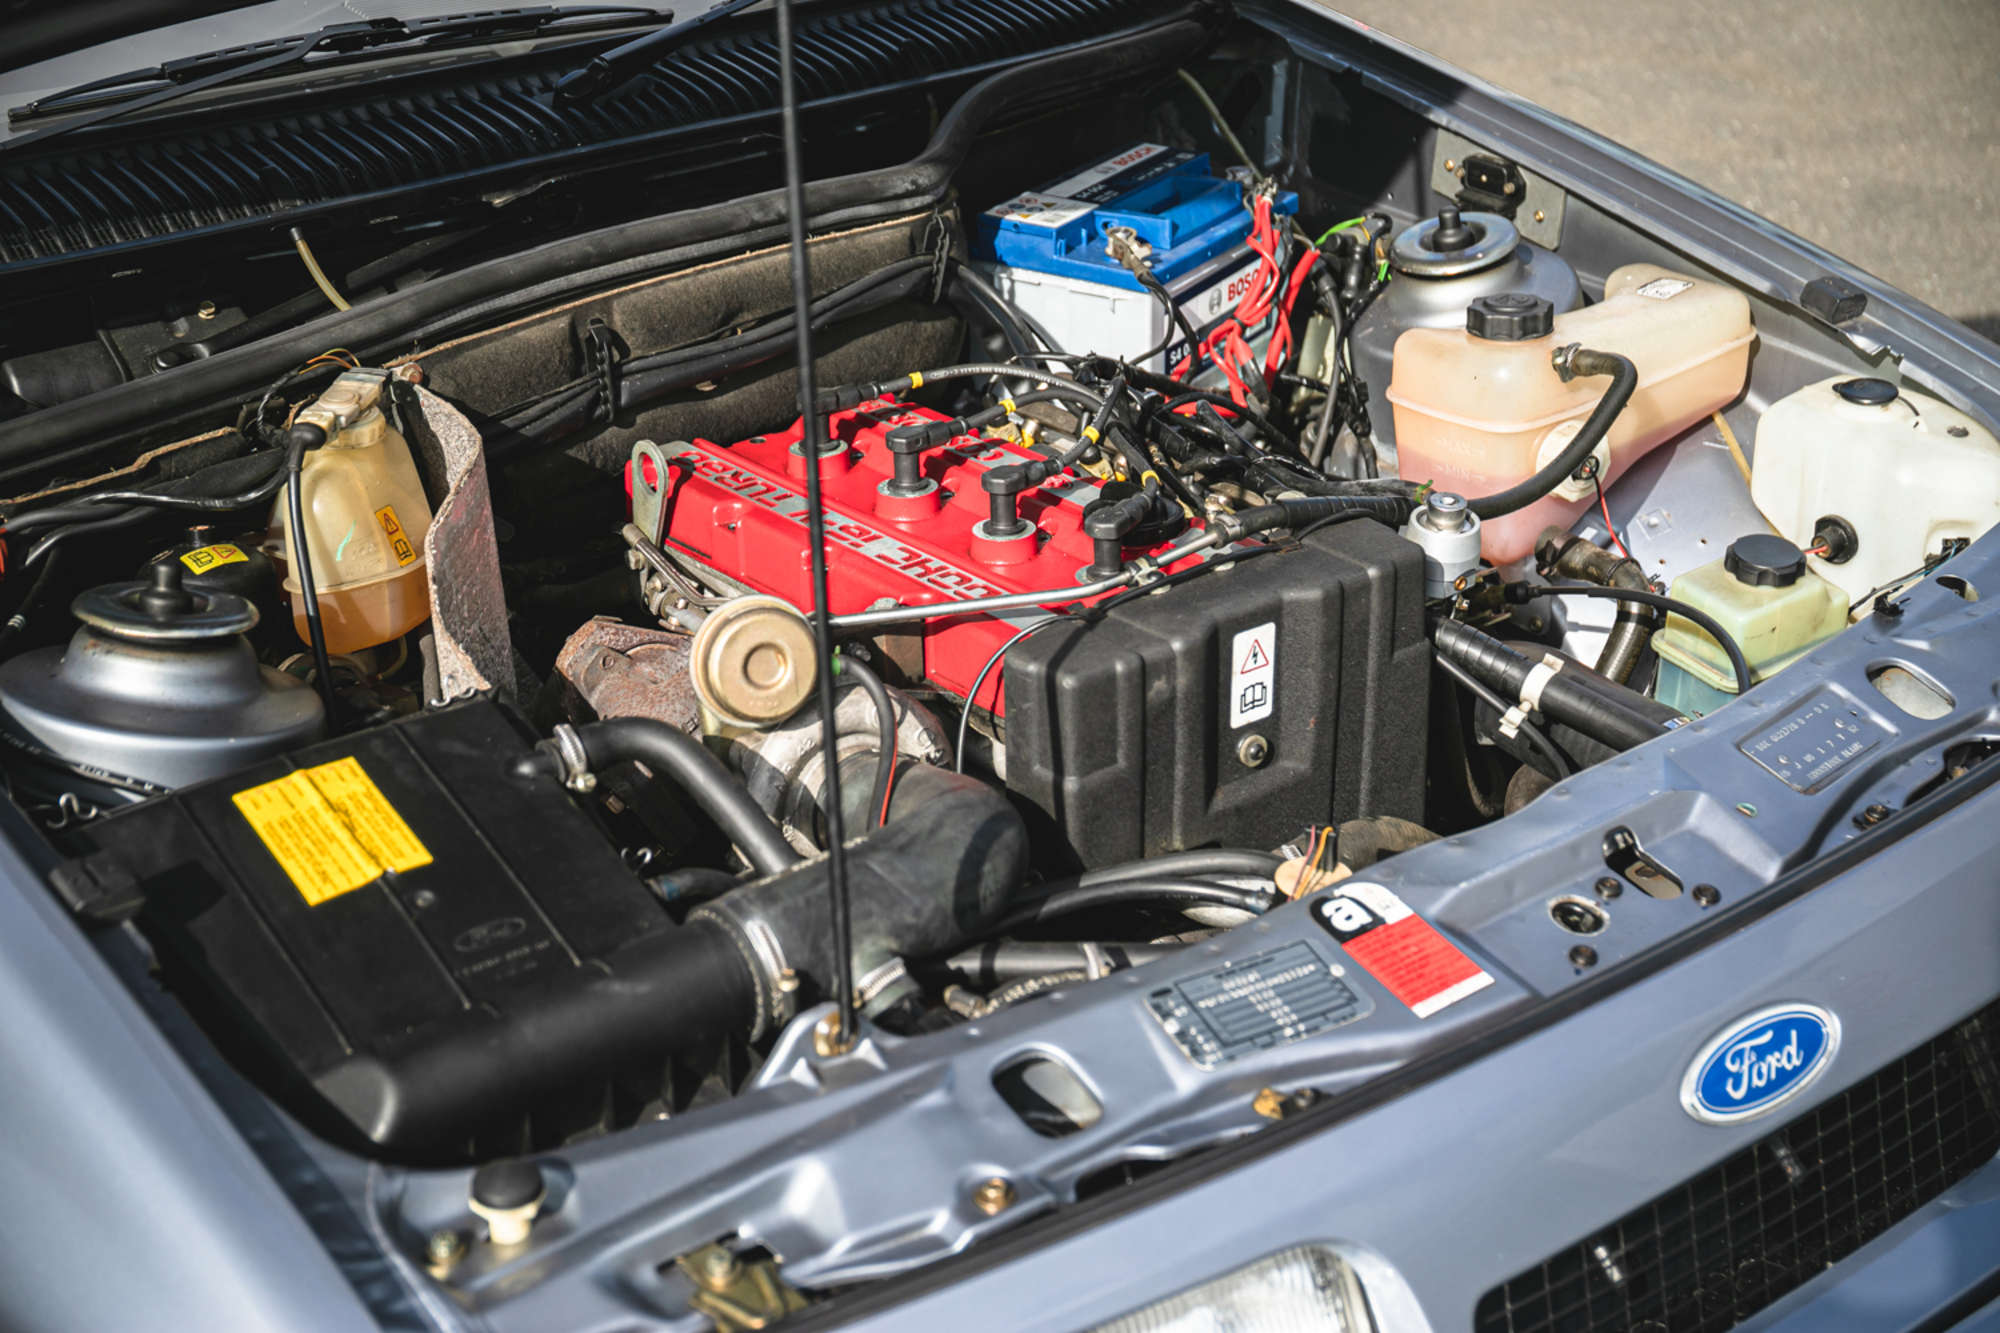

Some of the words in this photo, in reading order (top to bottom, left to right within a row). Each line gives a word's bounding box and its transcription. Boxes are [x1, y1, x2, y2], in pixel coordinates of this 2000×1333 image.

[677, 450, 795, 508] TURBO
[874, 545, 1003, 601] DOHC
[1724, 1029, 1804, 1101] Ford
